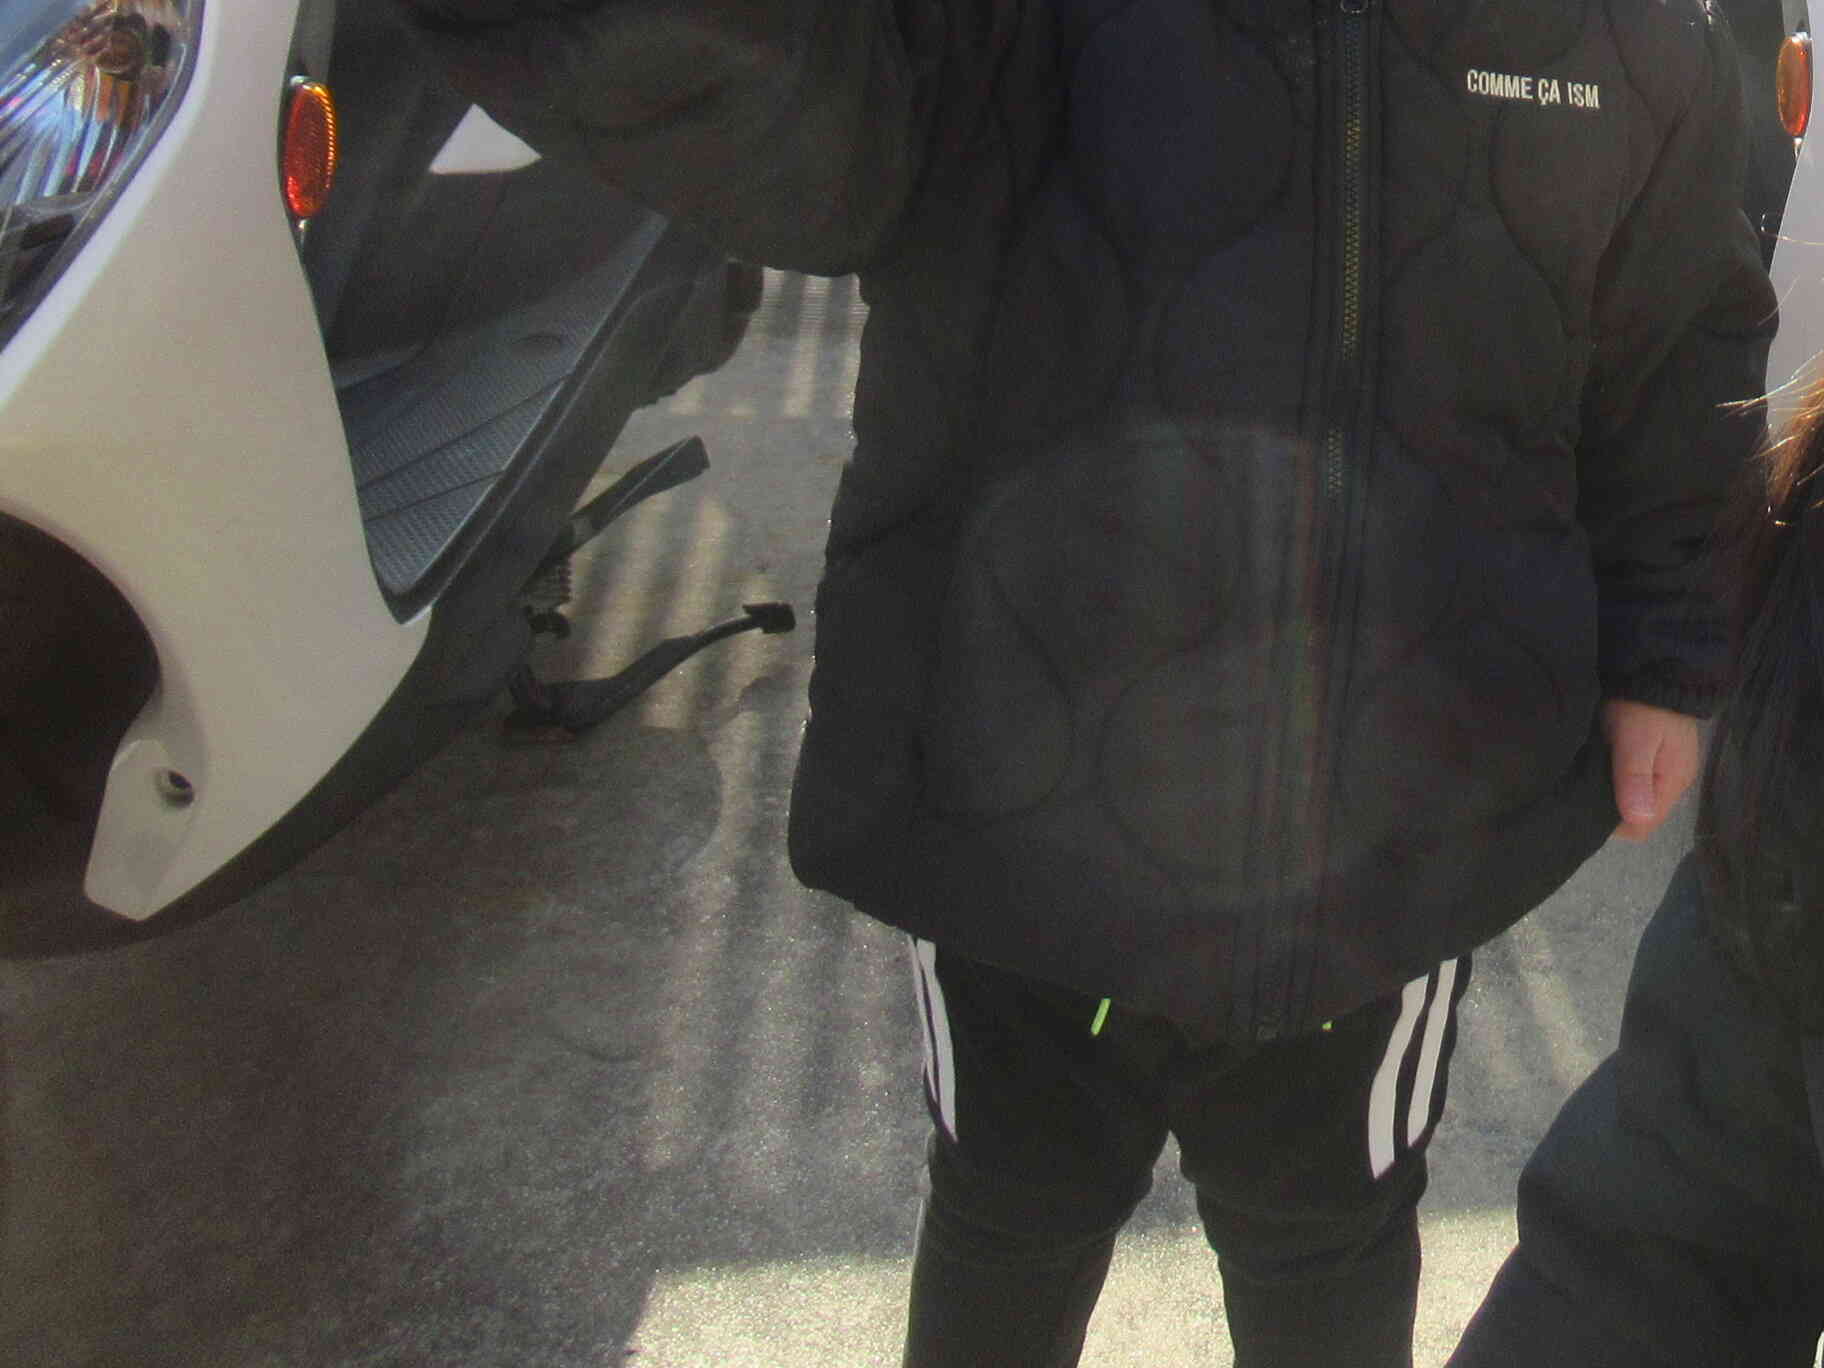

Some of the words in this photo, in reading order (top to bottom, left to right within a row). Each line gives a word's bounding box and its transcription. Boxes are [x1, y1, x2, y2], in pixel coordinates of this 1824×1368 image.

[1466, 68, 1534, 100] COMME
[1537, 78, 1561, 106] ÇA
[1567, 82, 1600, 109] ISM
